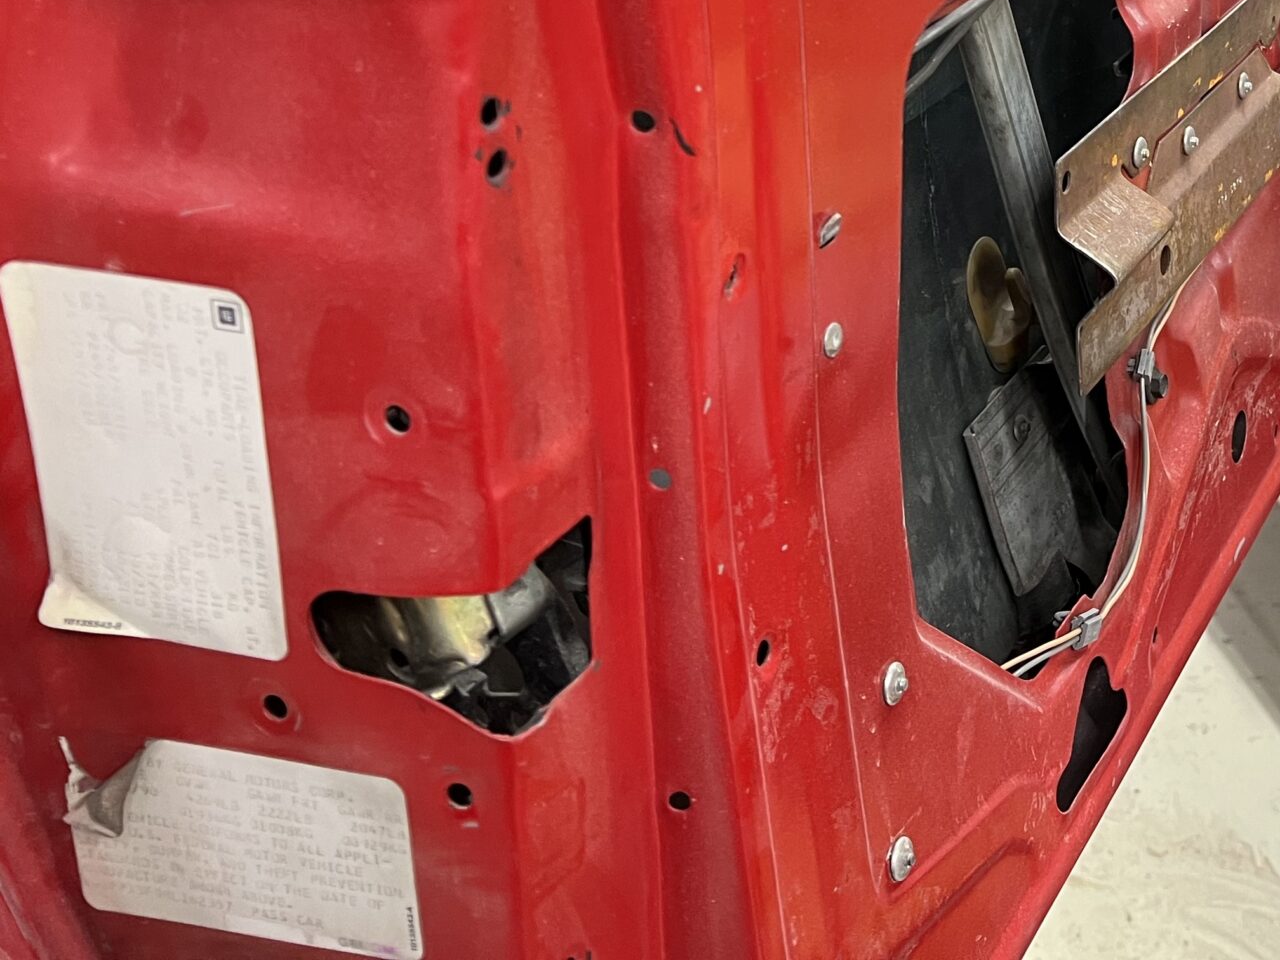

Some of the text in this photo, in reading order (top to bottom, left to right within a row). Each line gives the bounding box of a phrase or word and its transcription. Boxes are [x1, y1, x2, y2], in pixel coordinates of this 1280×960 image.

[232, 499, 252, 568] VEHICLE
[247, 503, 272, 611] INFORMATION
[191, 568, 213, 637] VEHICLE
[256, 864, 298, 882] THEFT
[310, 874, 405, 898] PREVENTION
[300, 857, 364, 878] VEHICLE
